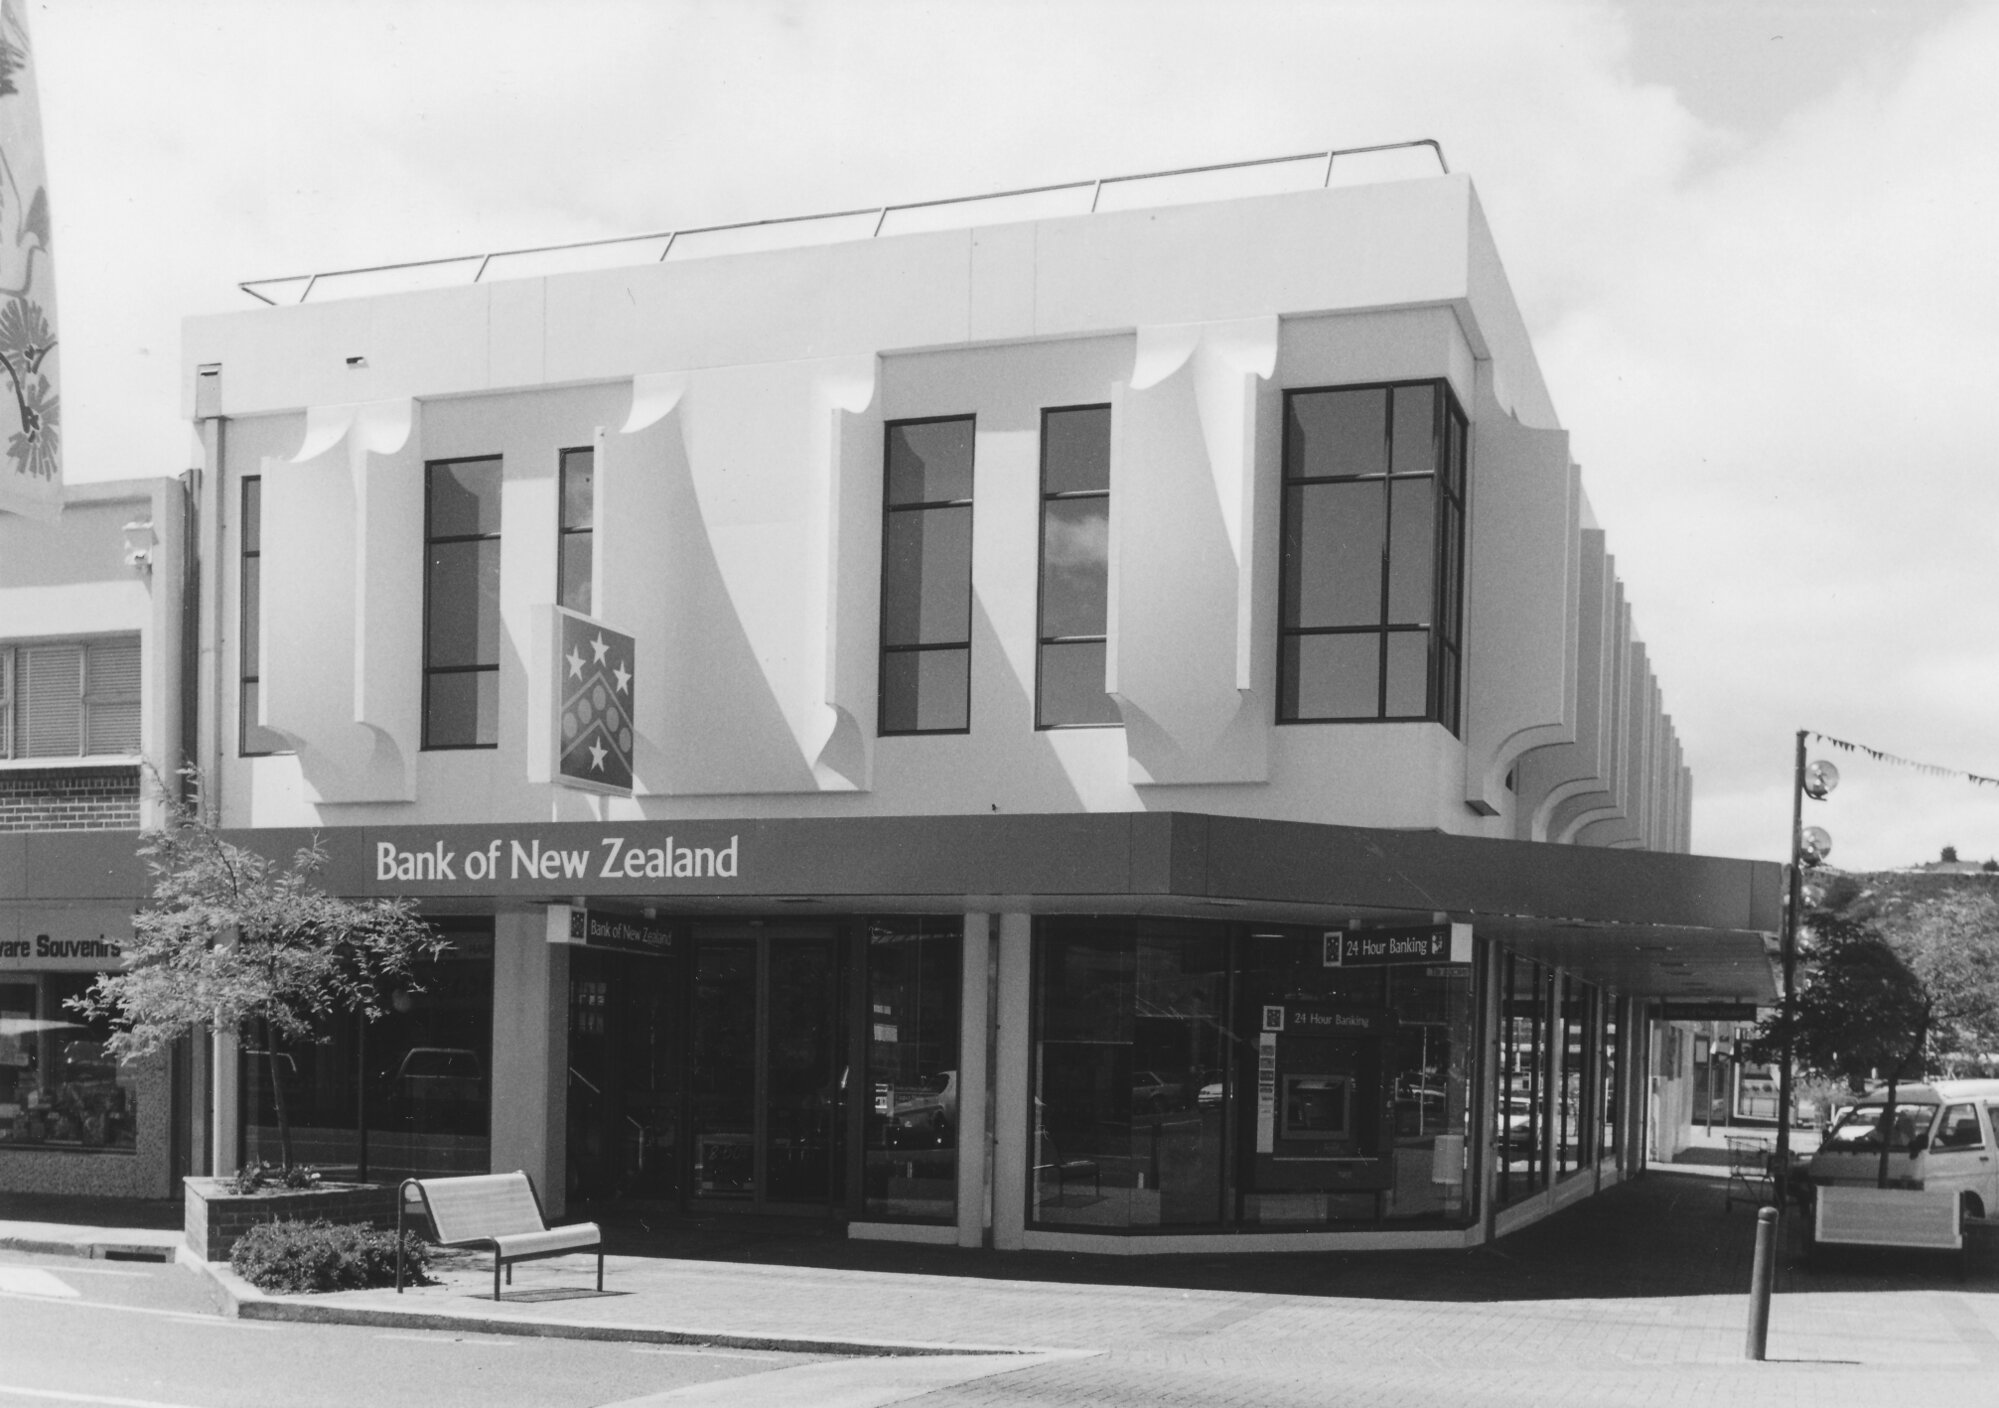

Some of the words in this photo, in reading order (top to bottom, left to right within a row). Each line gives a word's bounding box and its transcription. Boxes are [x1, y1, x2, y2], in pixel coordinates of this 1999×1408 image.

[377, 840, 456, 881] Bank
[465, 839, 502, 880] of
[510, 839, 590, 879] New
[600, 834, 739, 878] Zealand
[591, 919, 611, 937] Bank
[612, 922, 622, 939] of
[623, 924, 641, 941] New
[642, 927, 673, 946] Zealand
[0, 940, 31, 958] are
[36, 934, 121, 958] Souvenirs
[1346, 940, 1359, 956] 24
[1362, 939, 1387, 955] Hour
[1389, 937, 1428, 956] Banking
[1294, 1012, 1306, 1024] 24
[1310, 1013, 1333, 1025] Hour
[1335, 1014, 1370, 1029] Banking
